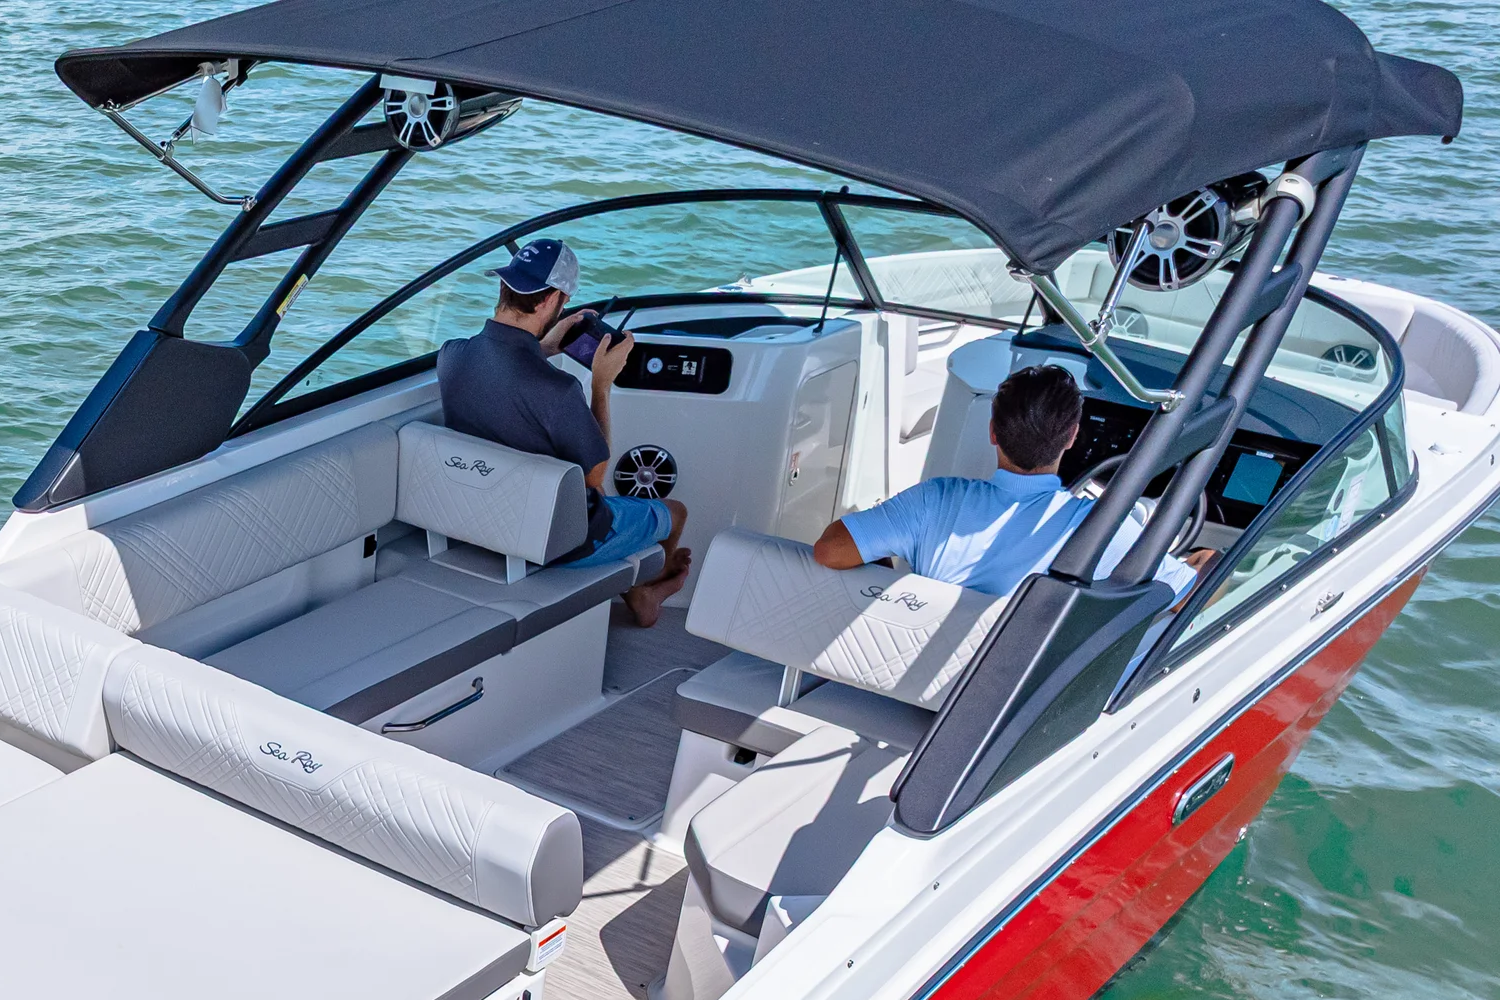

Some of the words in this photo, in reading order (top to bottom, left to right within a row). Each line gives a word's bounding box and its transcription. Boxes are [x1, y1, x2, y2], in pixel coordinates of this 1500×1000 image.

[444, 456, 469, 470] Sea
[470, 459, 495, 477] Ray
[860, 585, 893, 602] Sea
[894, 591, 928, 612] Ray
[259, 741, 290, 761] Sea
[290, 750, 323, 774] Ray
